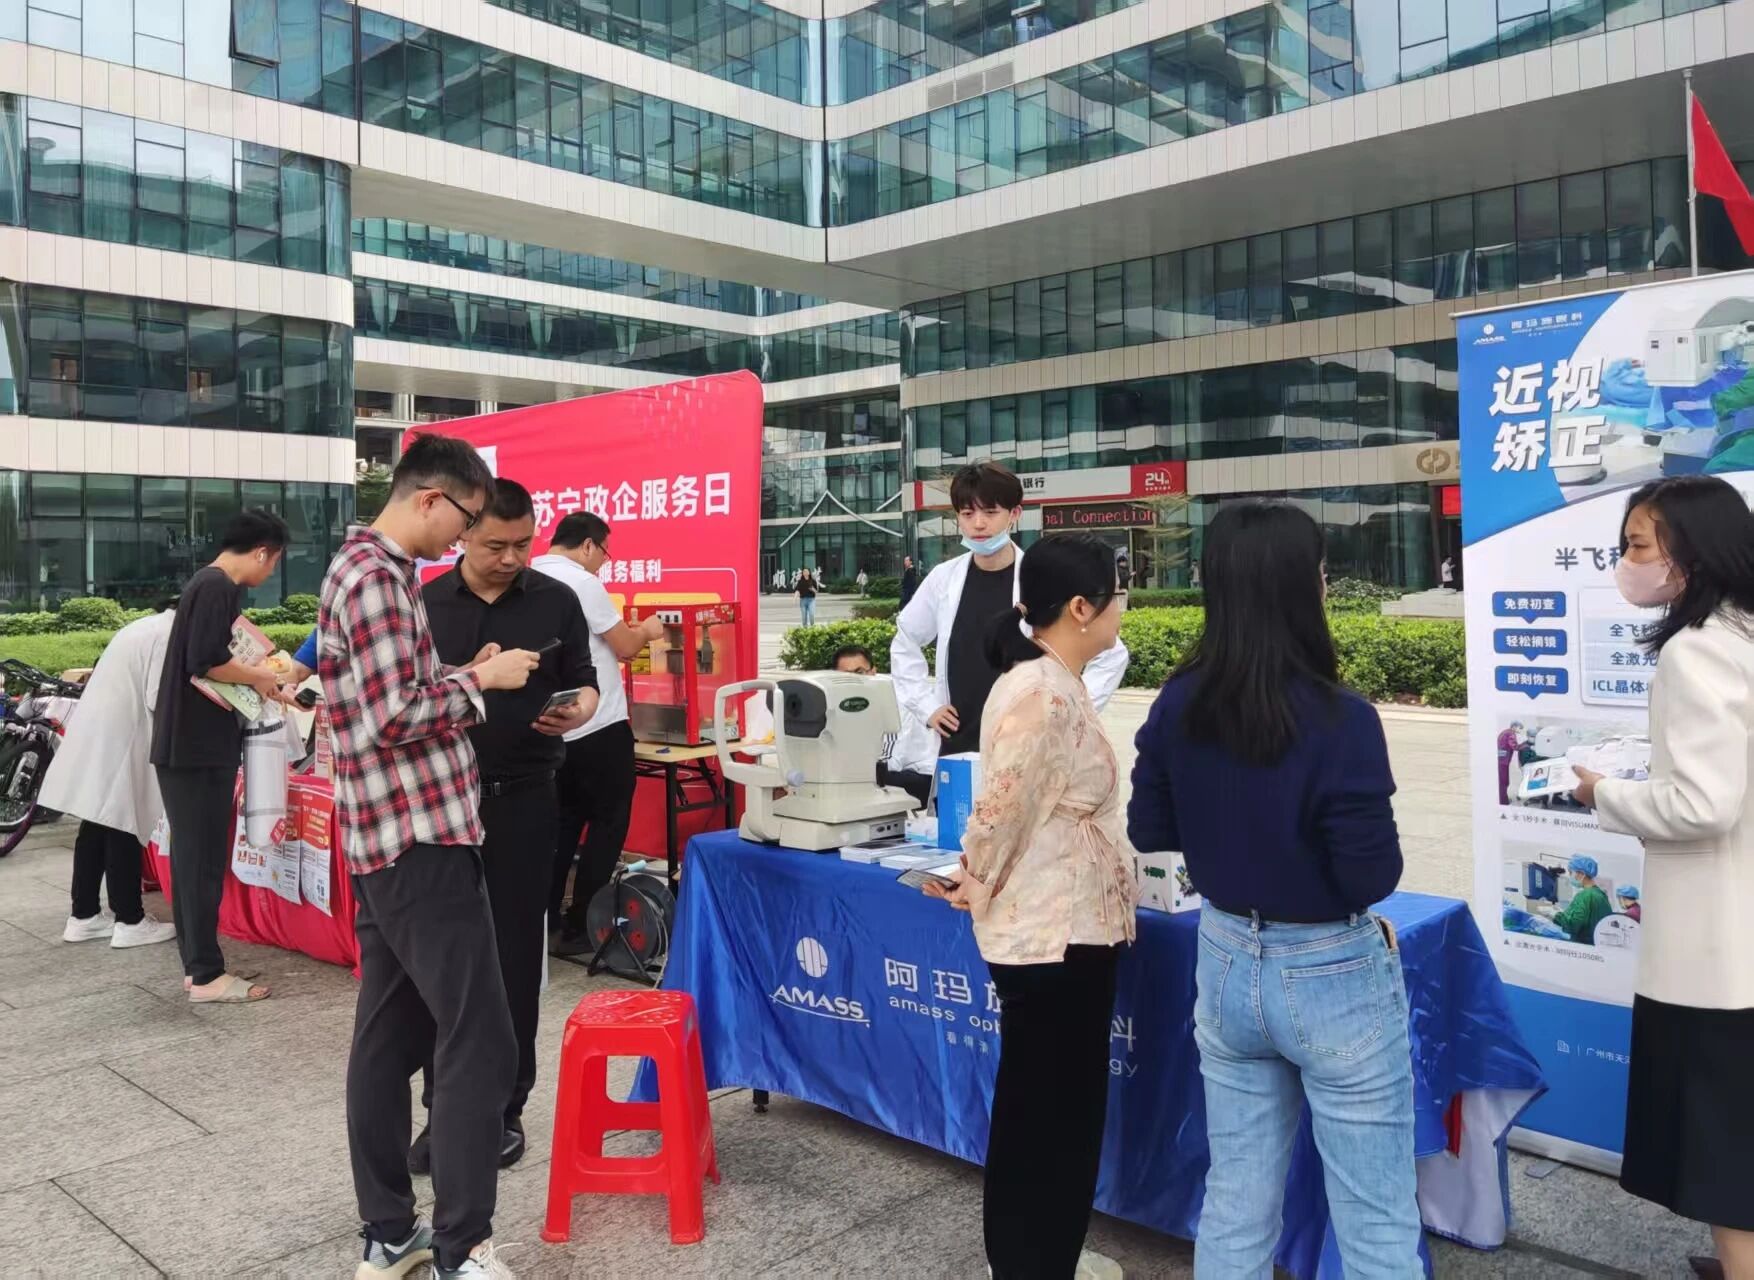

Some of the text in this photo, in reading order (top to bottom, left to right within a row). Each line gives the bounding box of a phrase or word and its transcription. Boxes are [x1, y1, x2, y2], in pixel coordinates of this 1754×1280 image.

[1489, 357, 1605, 416] 近视
[1491, 415, 1607, 473] 矫正
[532, 472, 730, 528] 苏宁政企服务日
[1504, 598, 1555, 611] 免费初查
[1506, 634, 1557, 649] 轻松摘镜
[1507, 672, 1557, 687] 即刻恢复
[1592, 679, 1649, 694] ICL晶体
[773, 984, 865, 1019] AMASS
[888, 996, 957, 1022] amass
